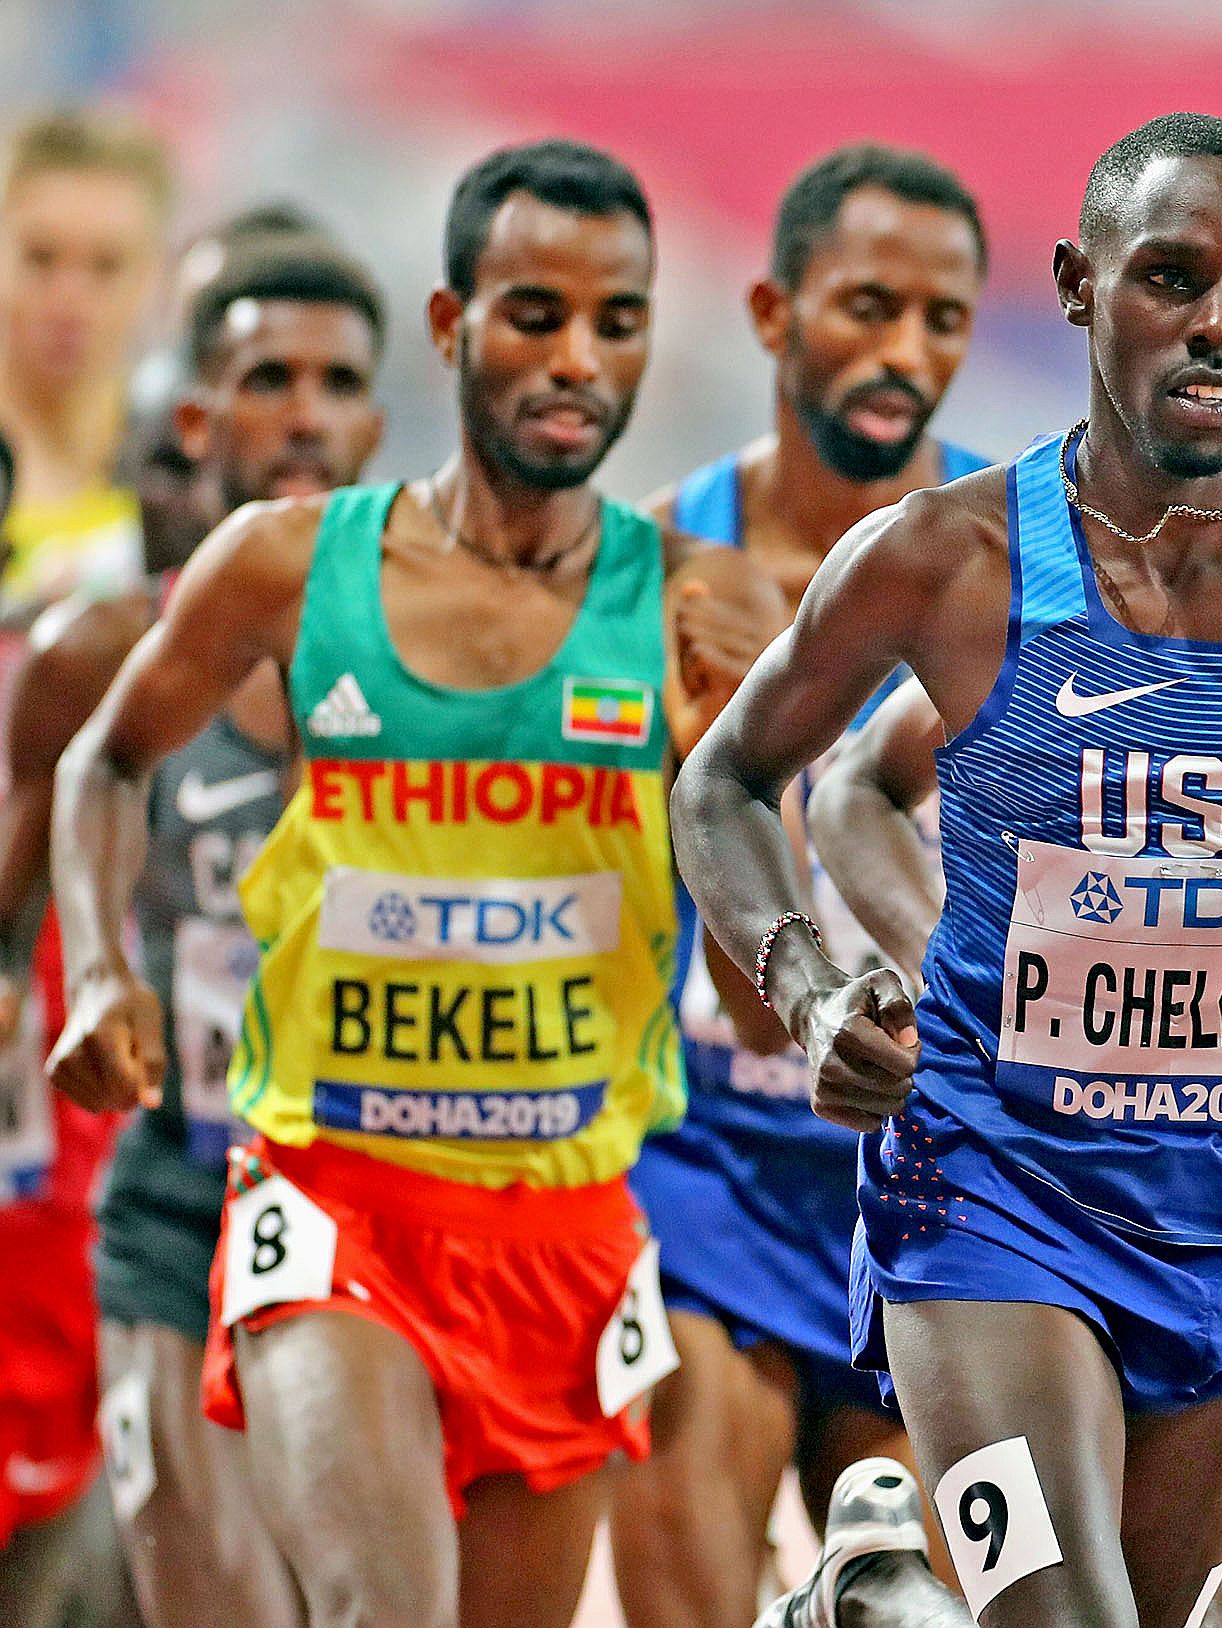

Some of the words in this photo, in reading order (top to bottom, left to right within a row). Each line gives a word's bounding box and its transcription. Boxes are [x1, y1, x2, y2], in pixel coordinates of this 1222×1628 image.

[309, 758, 643, 833] ETHIOPIA
[417, 892, 579, 945] TDK
[330, 973, 598, 1063] BEKELE
[1015, 950, 1062, 1039] P.
[360, 1089, 581, 1137] DOHA2019
[251, 1205, 287, 1275] 8
[958, 1480, 1009, 1574] 9
